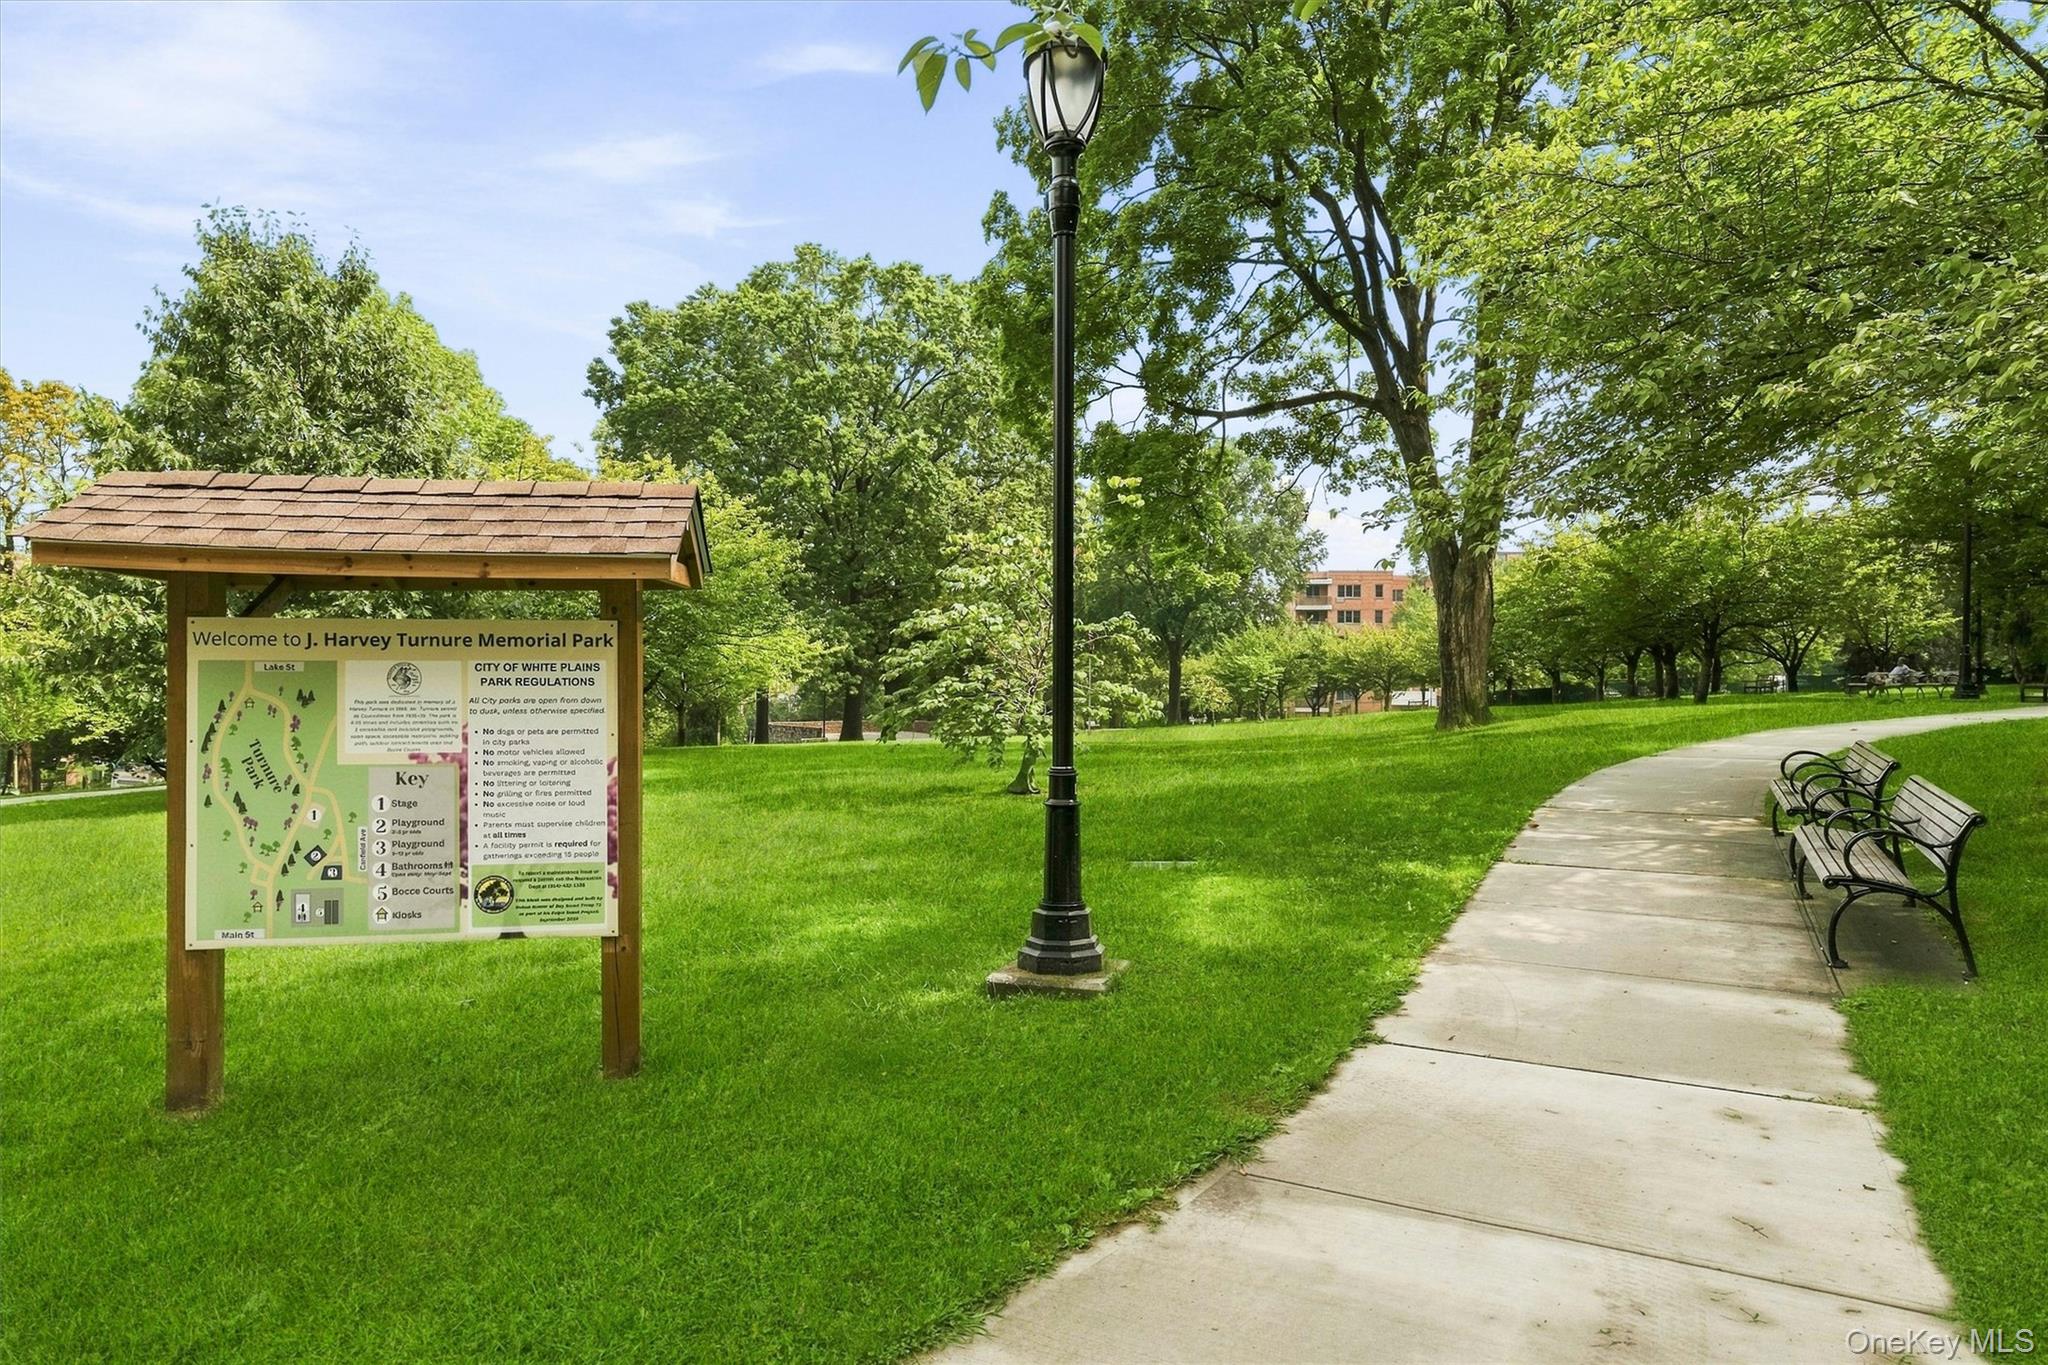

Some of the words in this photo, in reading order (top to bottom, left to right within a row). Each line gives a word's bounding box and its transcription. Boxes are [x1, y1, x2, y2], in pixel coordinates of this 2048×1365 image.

[193, 631, 277, 647] Welcome
[284, 633, 300, 648] to
[305, 632, 318, 649] J.
[324, 632, 391, 650] Harvey
[396, 633, 472, 648] Turnure
[479, 633, 566, 648] Memorial
[572, 633, 614, 648] Park
[474, 663, 500, 672] CITY
[503, 663, 518, 672] OF
[522, 663, 556, 672] WHITE
[560, 663, 600, 672] PLAINS
[480, 678, 512, 686] PARK
[516, 678, 595, 686] REGULATIONS
[482, 697, 497, 705] City
[499, 697, 520, 705] parks
[249, 738, 282, 794] Turnure
[241, 756, 264, 790] Park
[396, 772, 429, 788] Key
[377, 797, 384, 810] 1
[391, 799, 418, 809] Stage
[312, 810, 316, 820] 1
[376, 819, 386, 833] 2
[392, 818, 445, 828] Playground
[376, 840, 386, 855] 3
[392, 840, 445, 850] Playground
[554, 840, 588, 849] required
[574, 851, 600, 859] people
[376, 863, 388, 876] 4
[392, 862, 443, 871] Bathrooms
[378, 886, 388, 900] 5
[423, 886, 454, 894] Courts
[392, 911, 422, 919] Kiosks
[221, 931, 242, 939] Main
[244, 930, 254, 938] St
